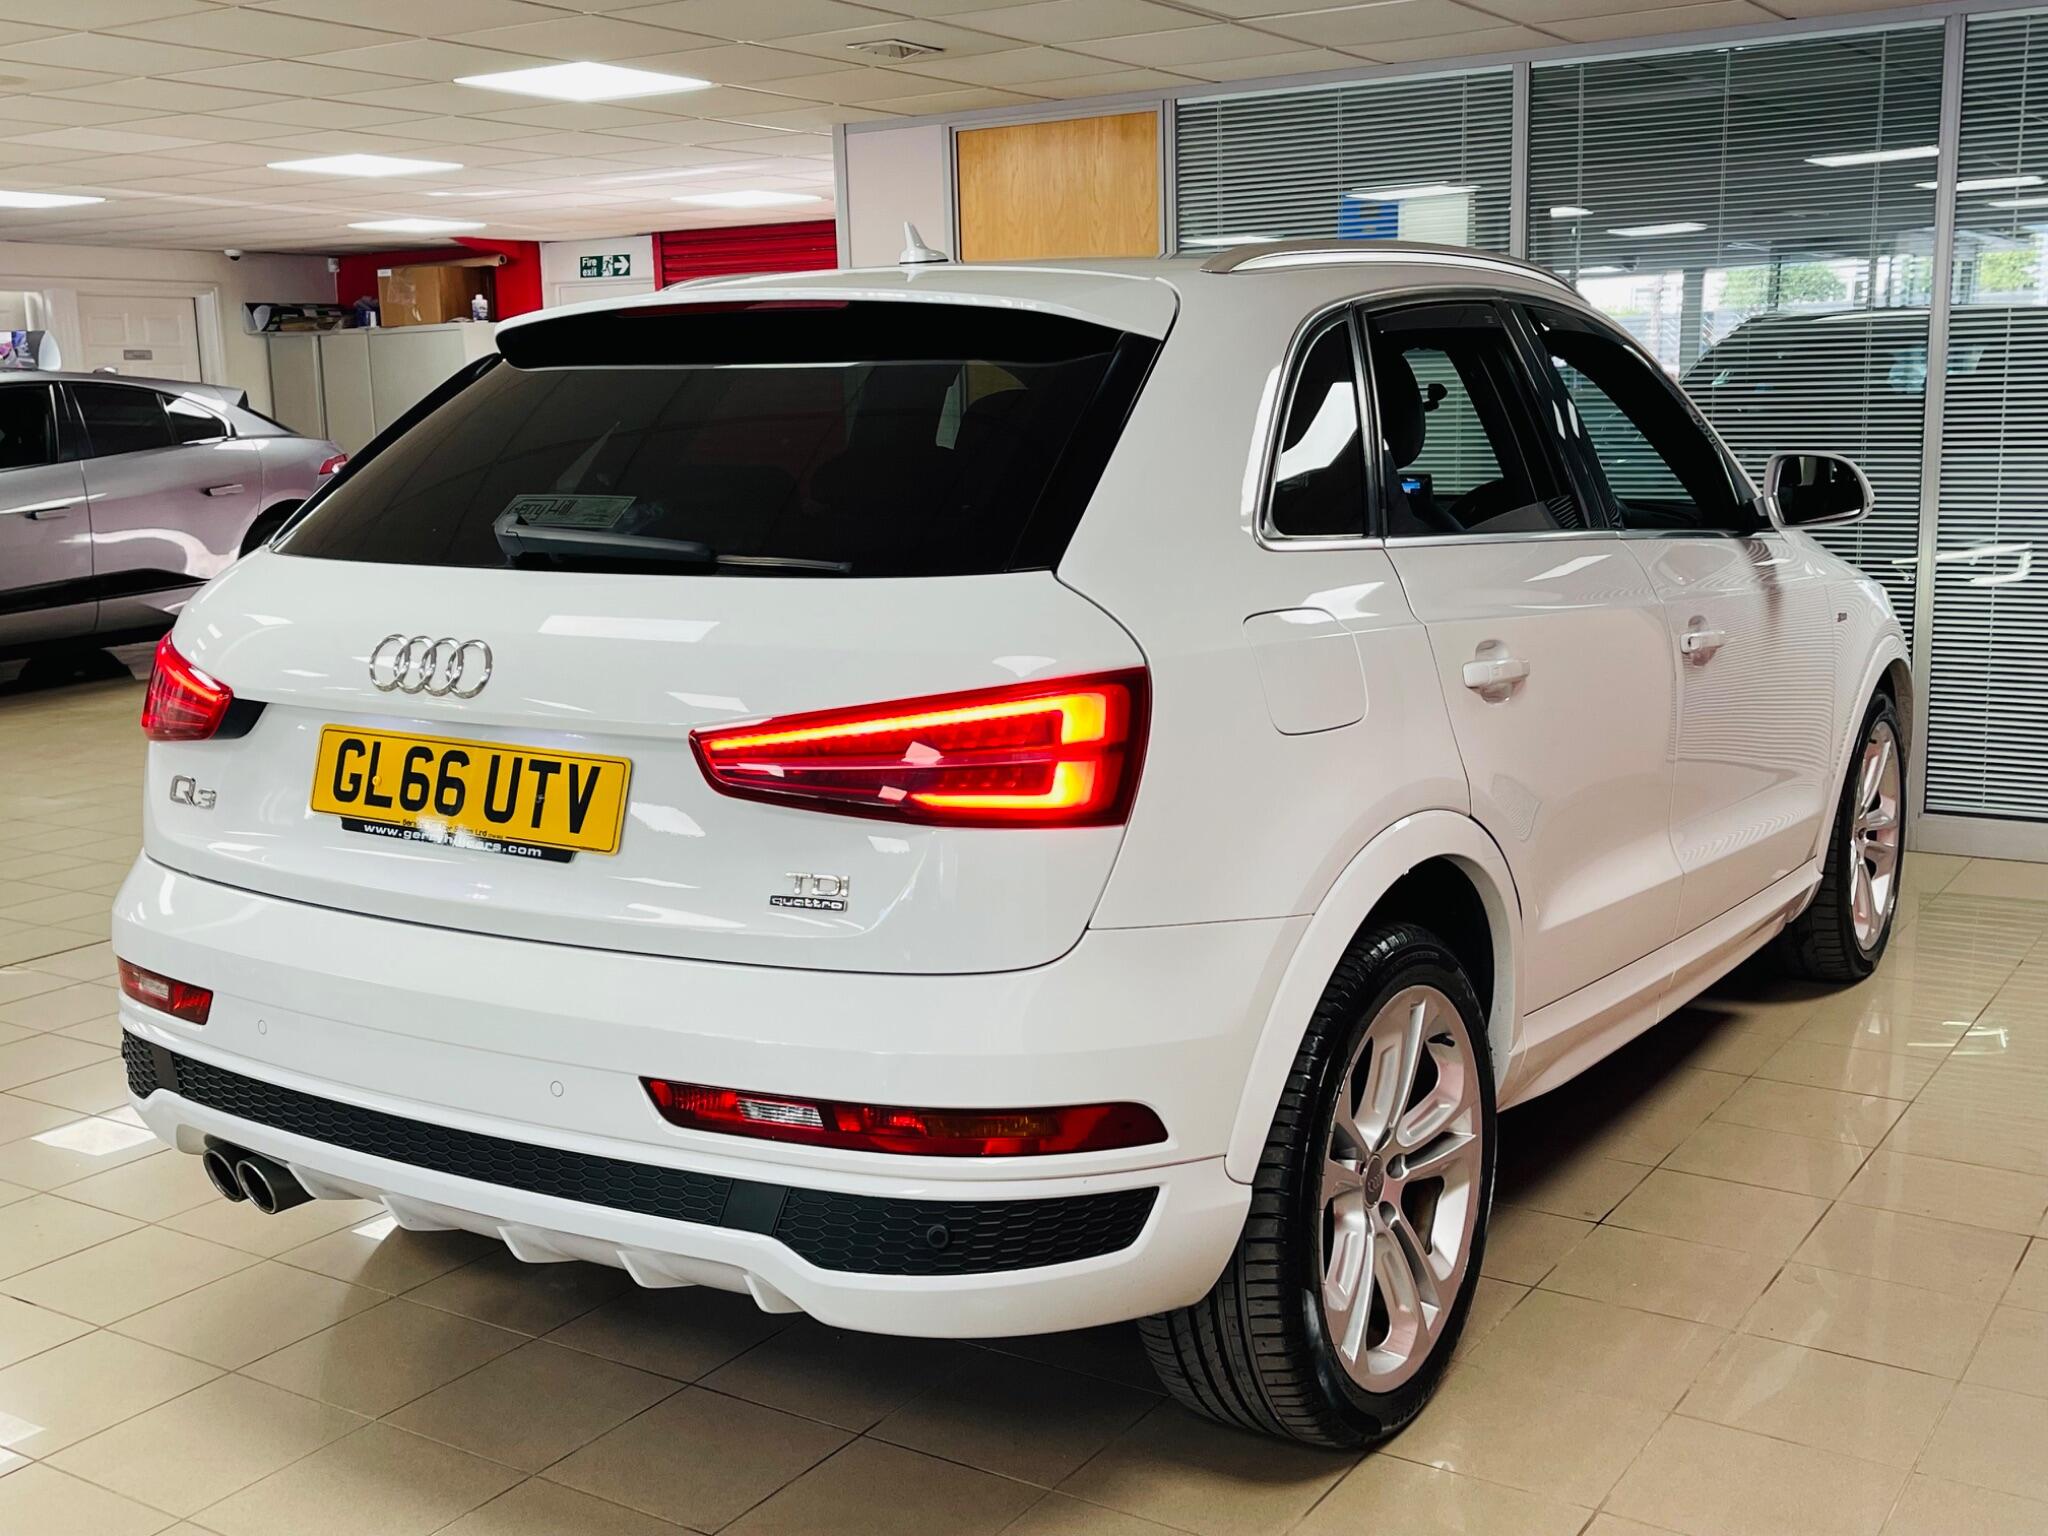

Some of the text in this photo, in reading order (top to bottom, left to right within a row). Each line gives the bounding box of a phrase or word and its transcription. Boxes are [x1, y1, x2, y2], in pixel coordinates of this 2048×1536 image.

[582, 257, 597, 267] Fire
[582, 267, 597, 277] exit
[169, 774, 217, 810] Q3
[332, 738, 602, 834] GL66 UTV
[785, 872, 849, 897] TDI
[771, 896, 843, 910] quattro
